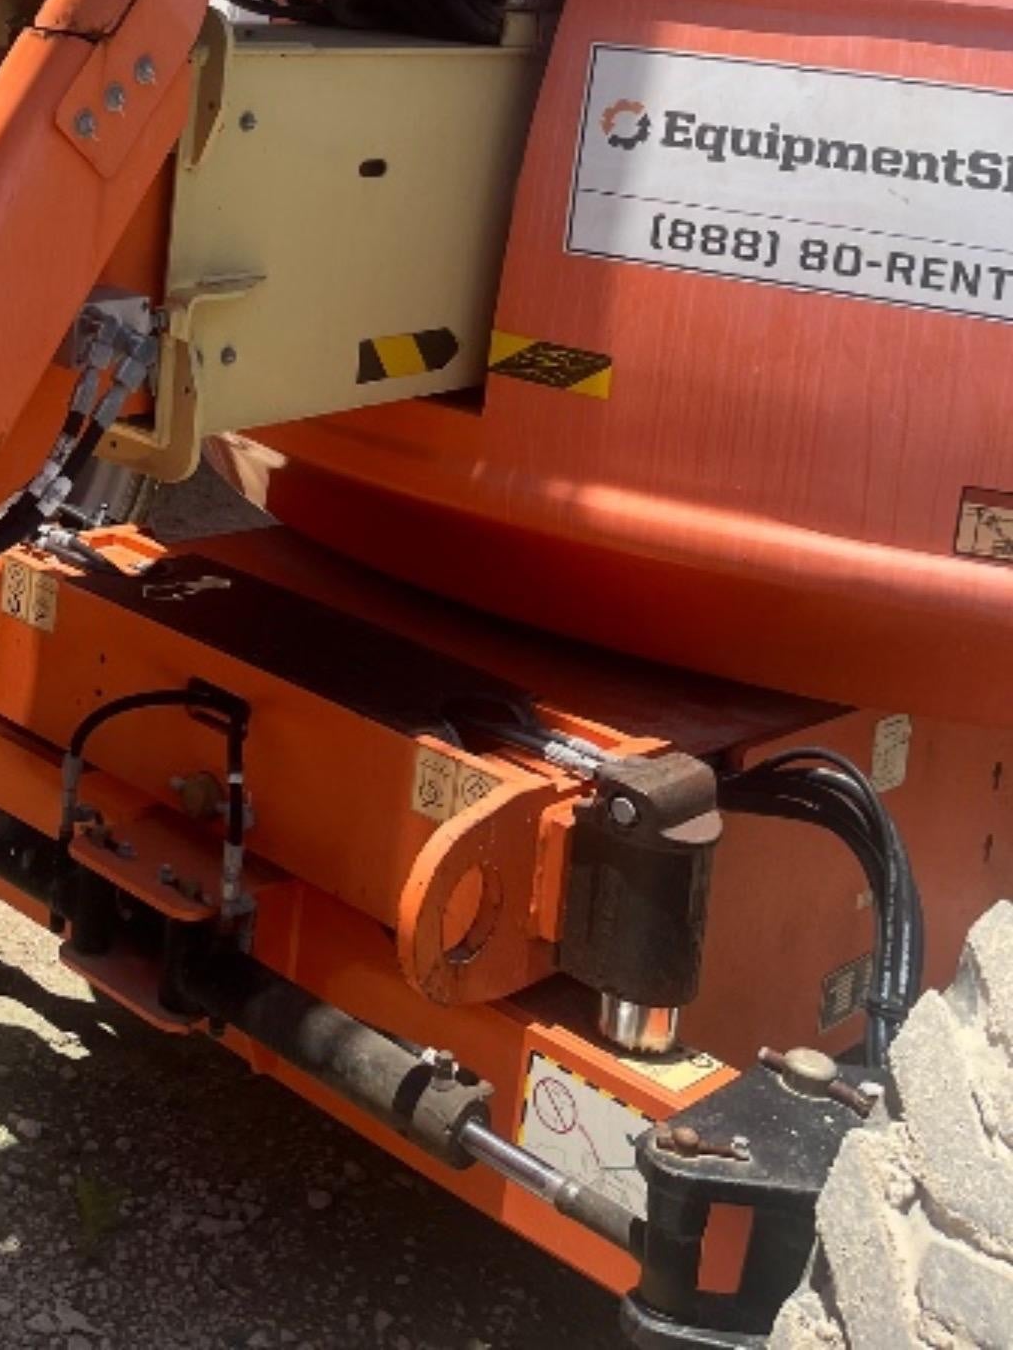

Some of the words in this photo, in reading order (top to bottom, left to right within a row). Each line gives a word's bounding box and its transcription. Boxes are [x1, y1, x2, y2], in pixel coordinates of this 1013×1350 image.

[660, 110, 1013, 192] EquipmentS
[650, 213, 780, 267] (888)
[799, 239, 1013, 300] 80-RENT
